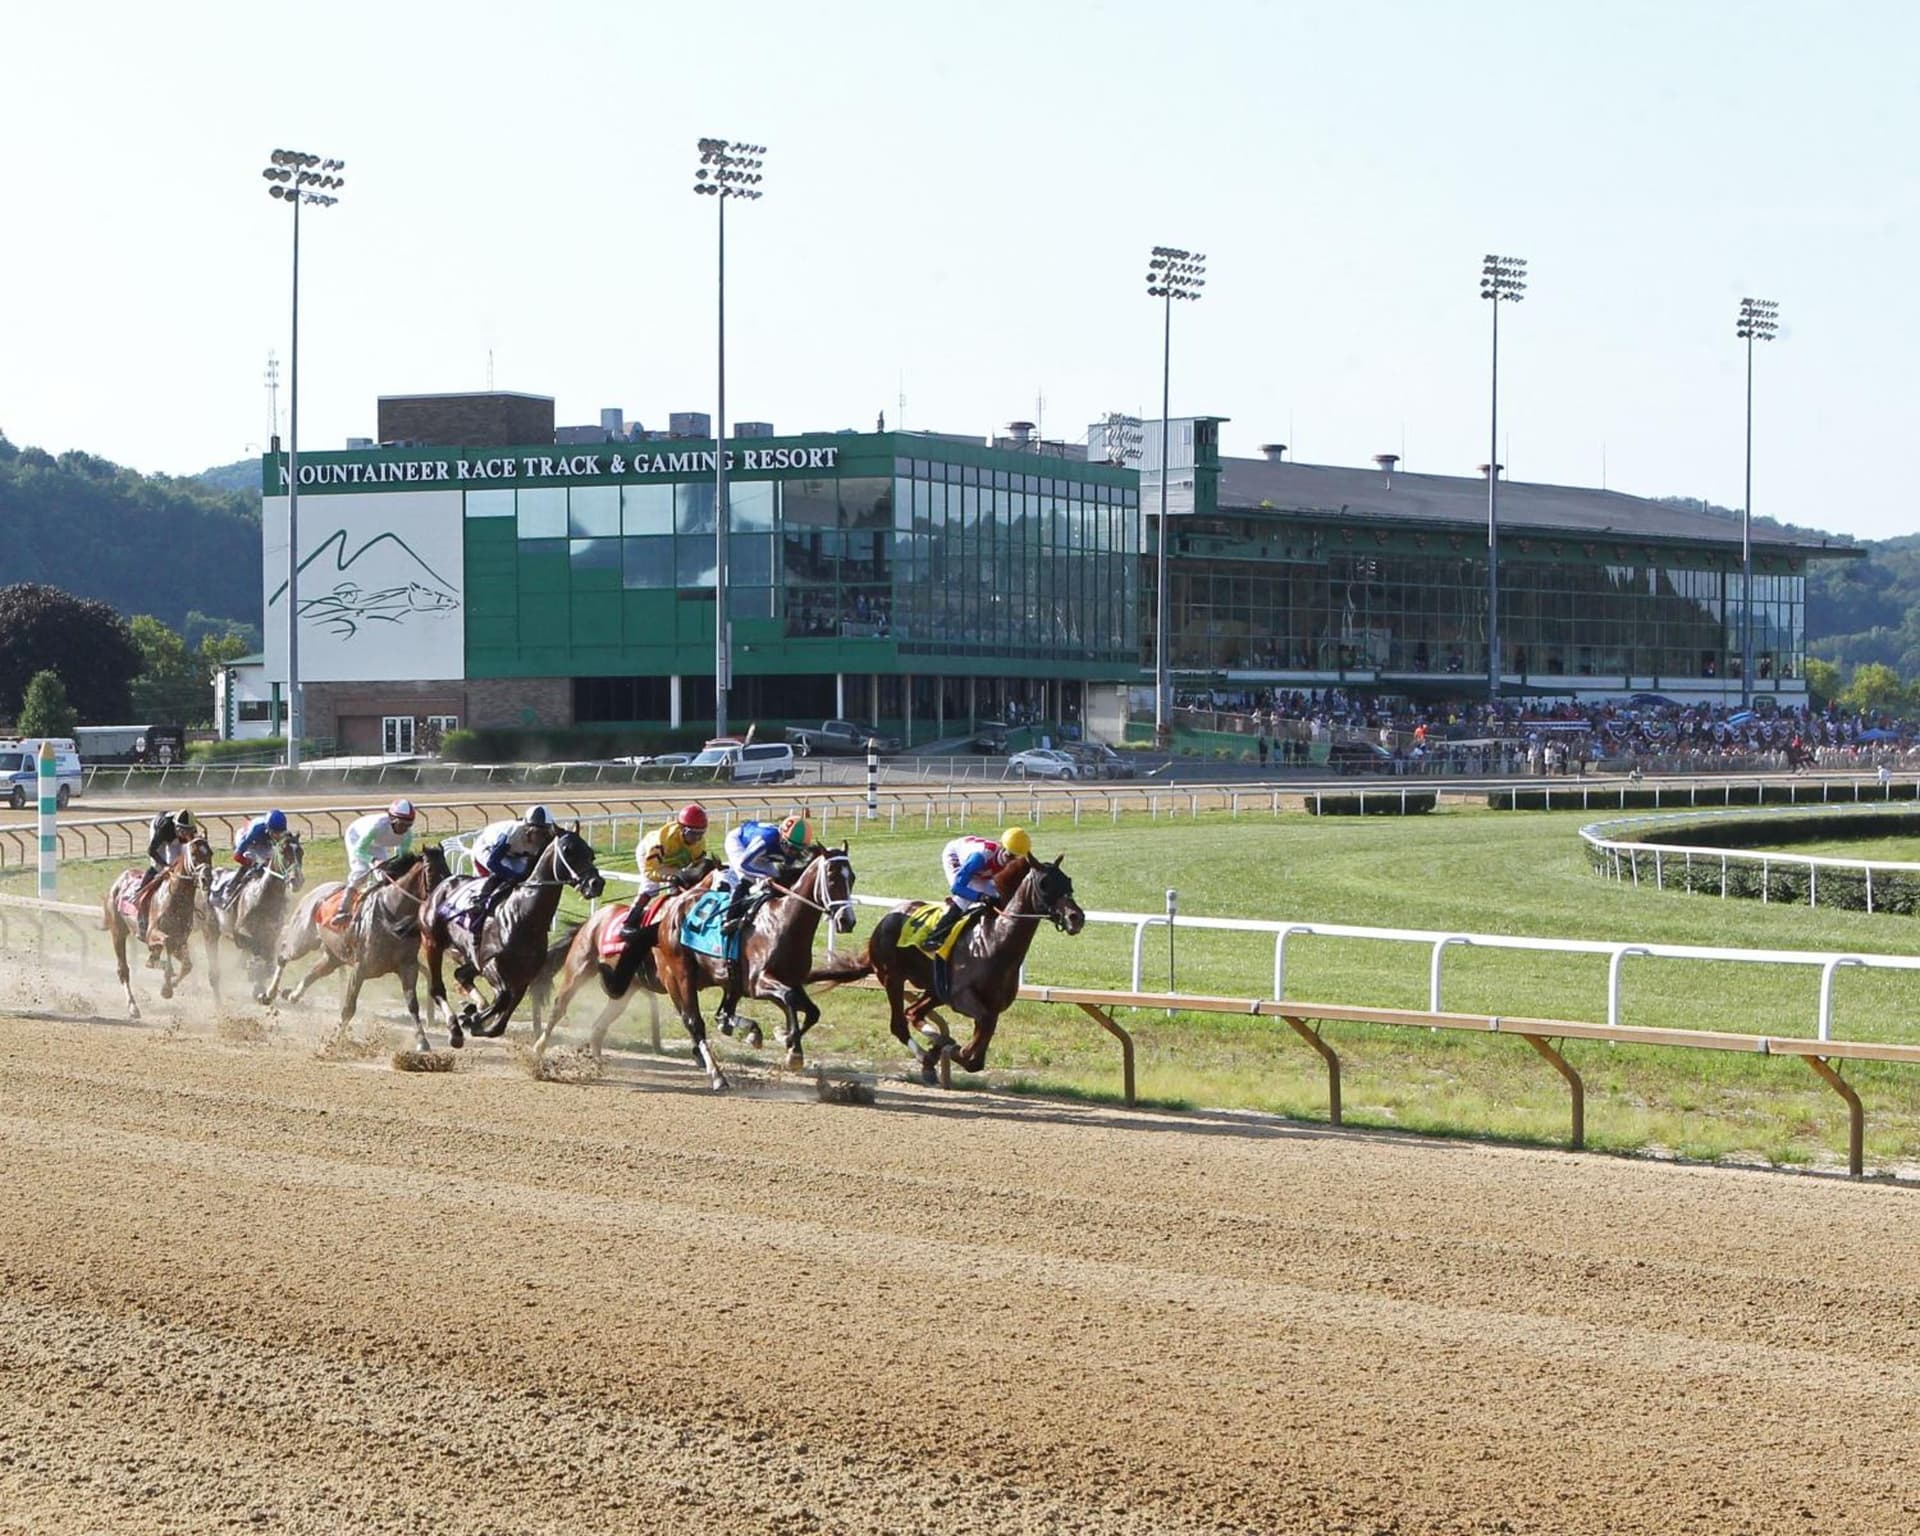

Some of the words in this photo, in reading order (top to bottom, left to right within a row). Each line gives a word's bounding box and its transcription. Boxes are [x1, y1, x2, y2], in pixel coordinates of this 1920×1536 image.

[456, 458, 516, 480] RACE
[523, 455, 601, 477] TRACK
[611, 454, 626, 473] &
[744, 447, 838, 469] RESORT
